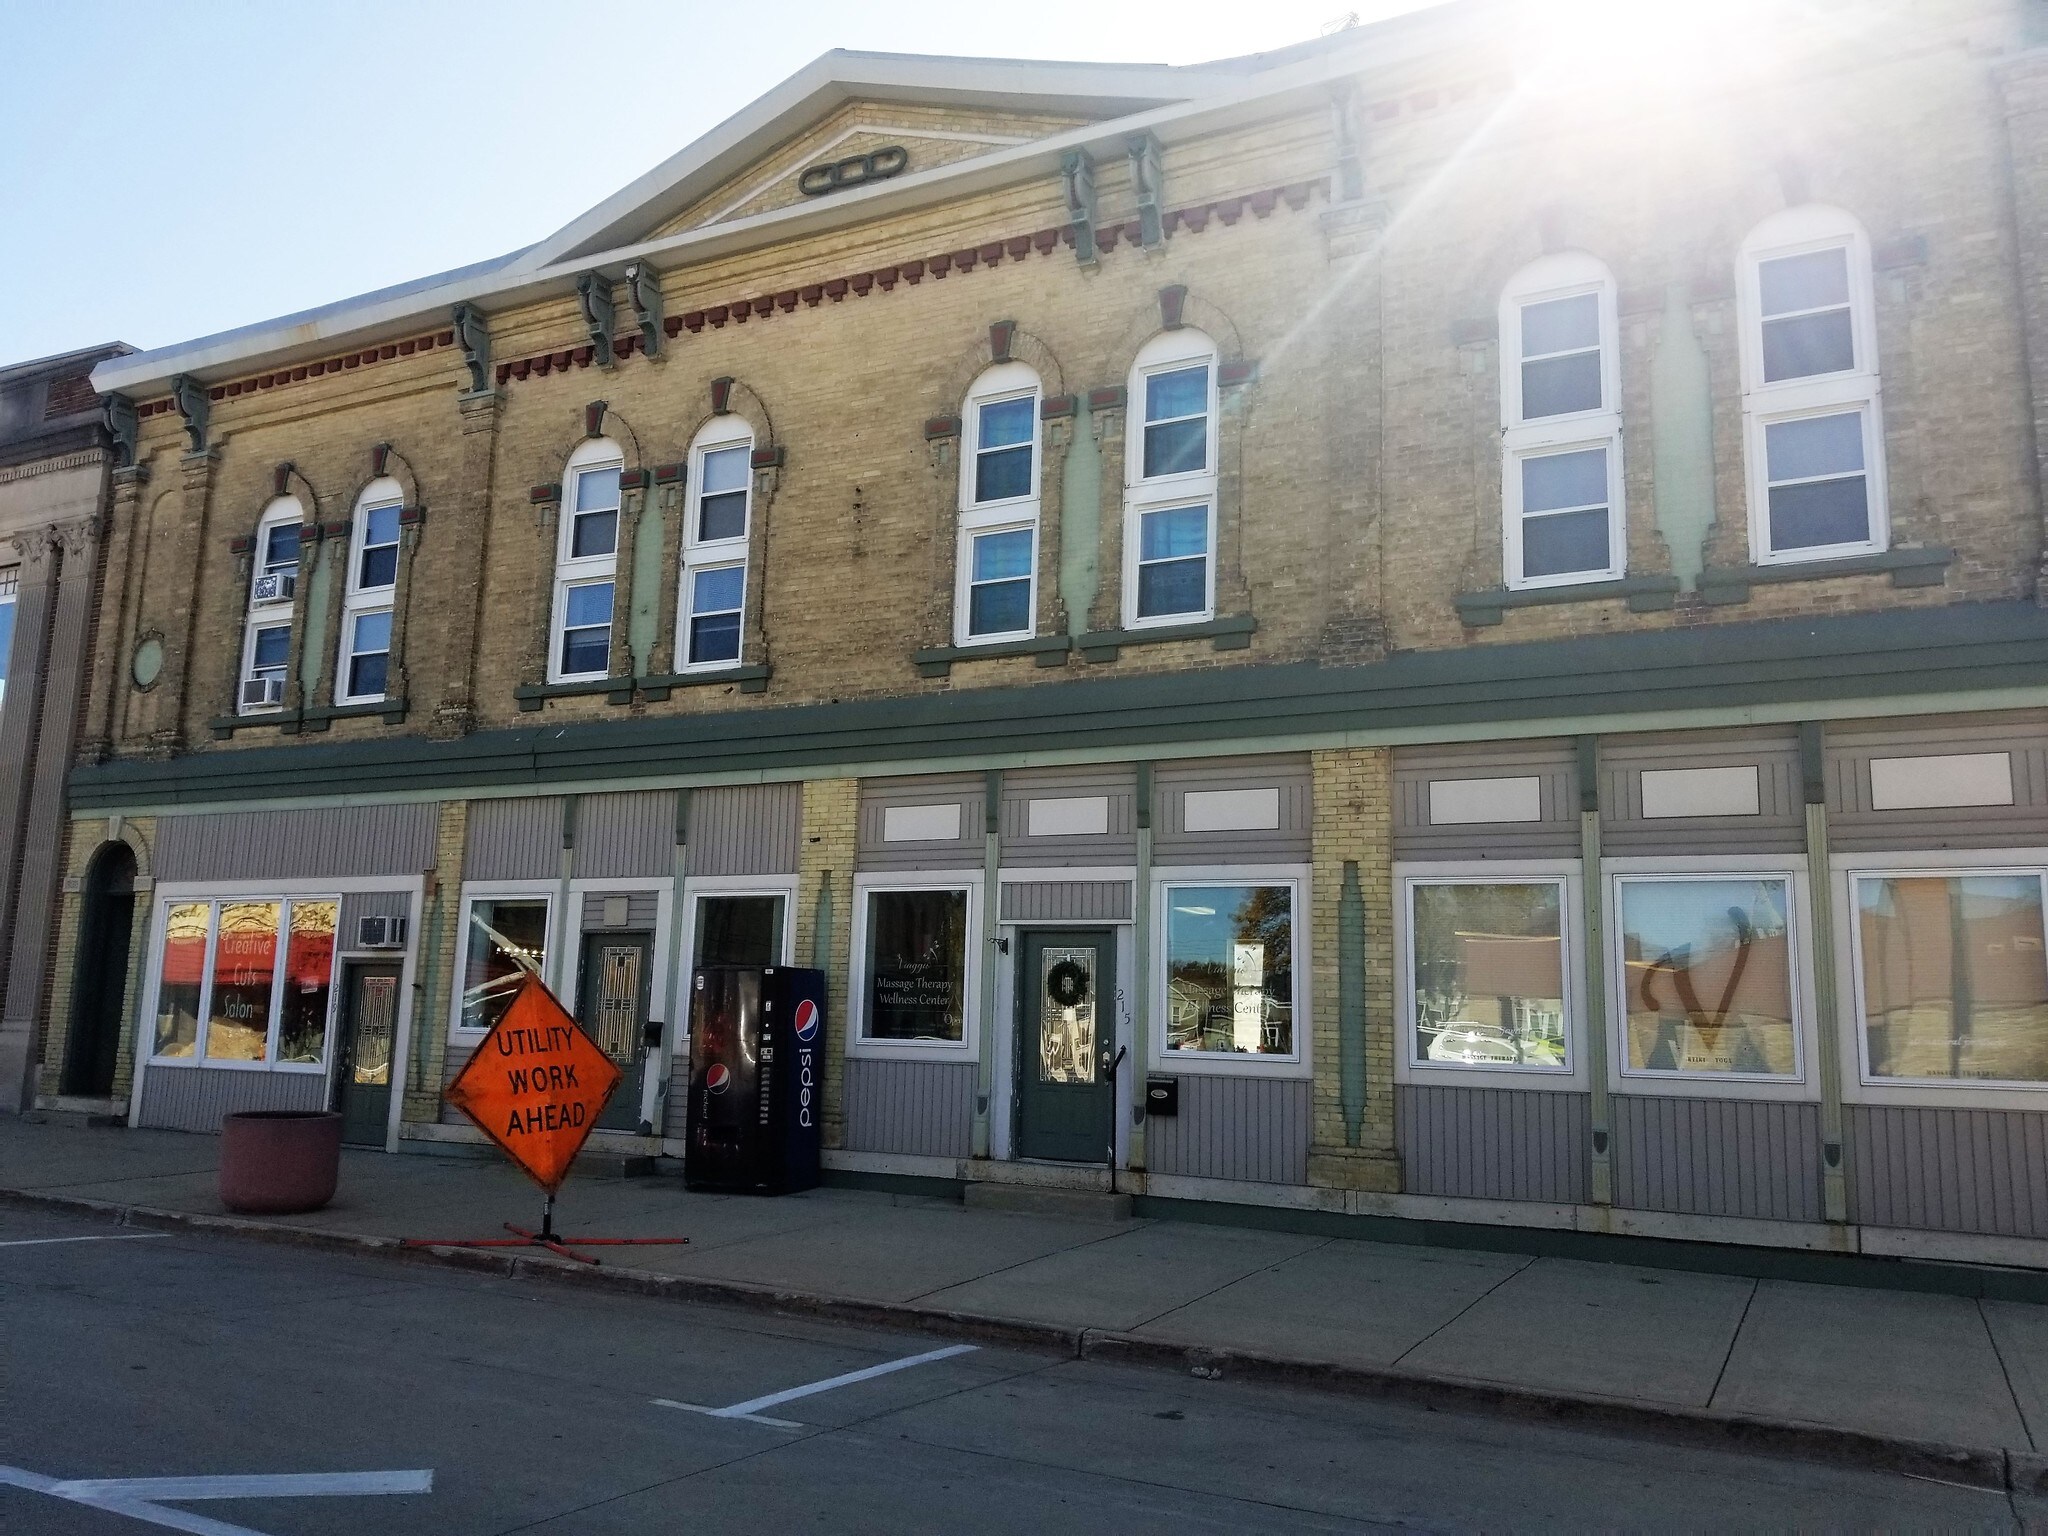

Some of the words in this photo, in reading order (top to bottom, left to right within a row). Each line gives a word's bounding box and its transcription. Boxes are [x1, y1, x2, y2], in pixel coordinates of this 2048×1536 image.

[225, 932, 272, 955] Creative
[234, 962, 257, 986] Cuts
[877, 977, 914, 992] Massage
[915, 976, 954, 993] Therapy
[224, 993, 253, 1018] Salon
[879, 992, 918, 1005] Wellness
[919, 993, 950, 1005] Center
[1117, 989, 1131, 1025] 215
[497, 1026, 573, 1057] UTILITY
[508, 1064, 579, 1095] WORK
[799, 1048, 814, 1127] pepsi
[506, 1102, 586, 1137] AHEAD
